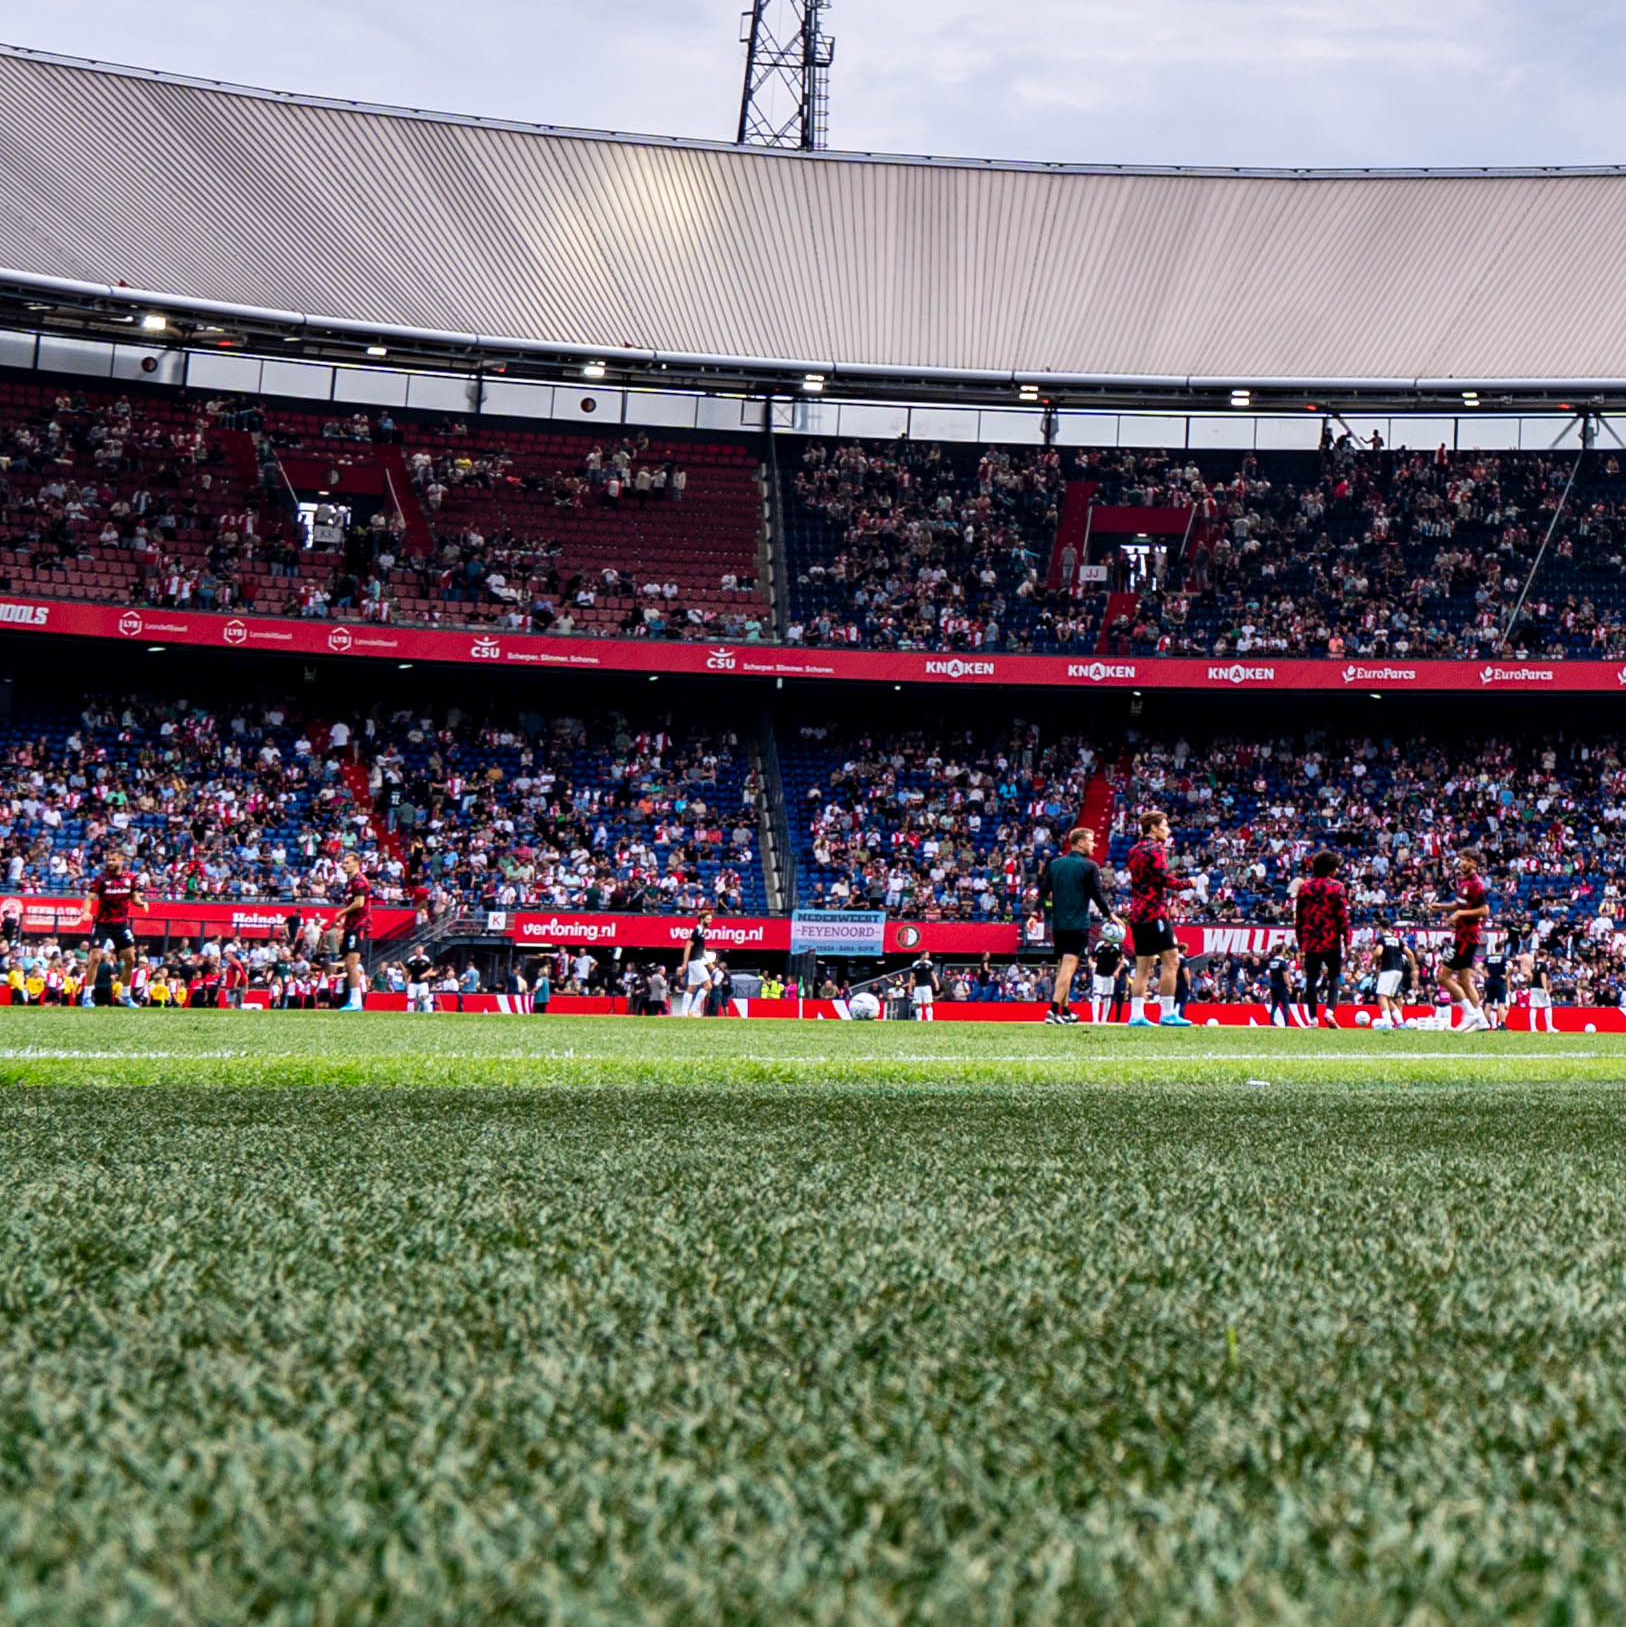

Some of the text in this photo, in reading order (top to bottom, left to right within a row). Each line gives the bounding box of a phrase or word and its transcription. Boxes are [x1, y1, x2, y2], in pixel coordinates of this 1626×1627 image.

[1086, 568, 1099, 578] JJ
[0, 603, 49, 625] OOLS
[470, 646, 500, 659] CSU
[706, 657, 736, 670] CSU
[925, 659, 994, 677] KNAKEN
[1068, 663, 1135, 679] KNAKEN
[1208, 666, 1274, 682] KNAKEN
[1356, 667, 1415, 680] EuroParcs
[1493, 669, 1553, 681] EuroParcs
[492, 915, 501, 927] K
[523, 919, 616, 940] verloning.nl
[670, 925, 763, 945] veroning.nl
